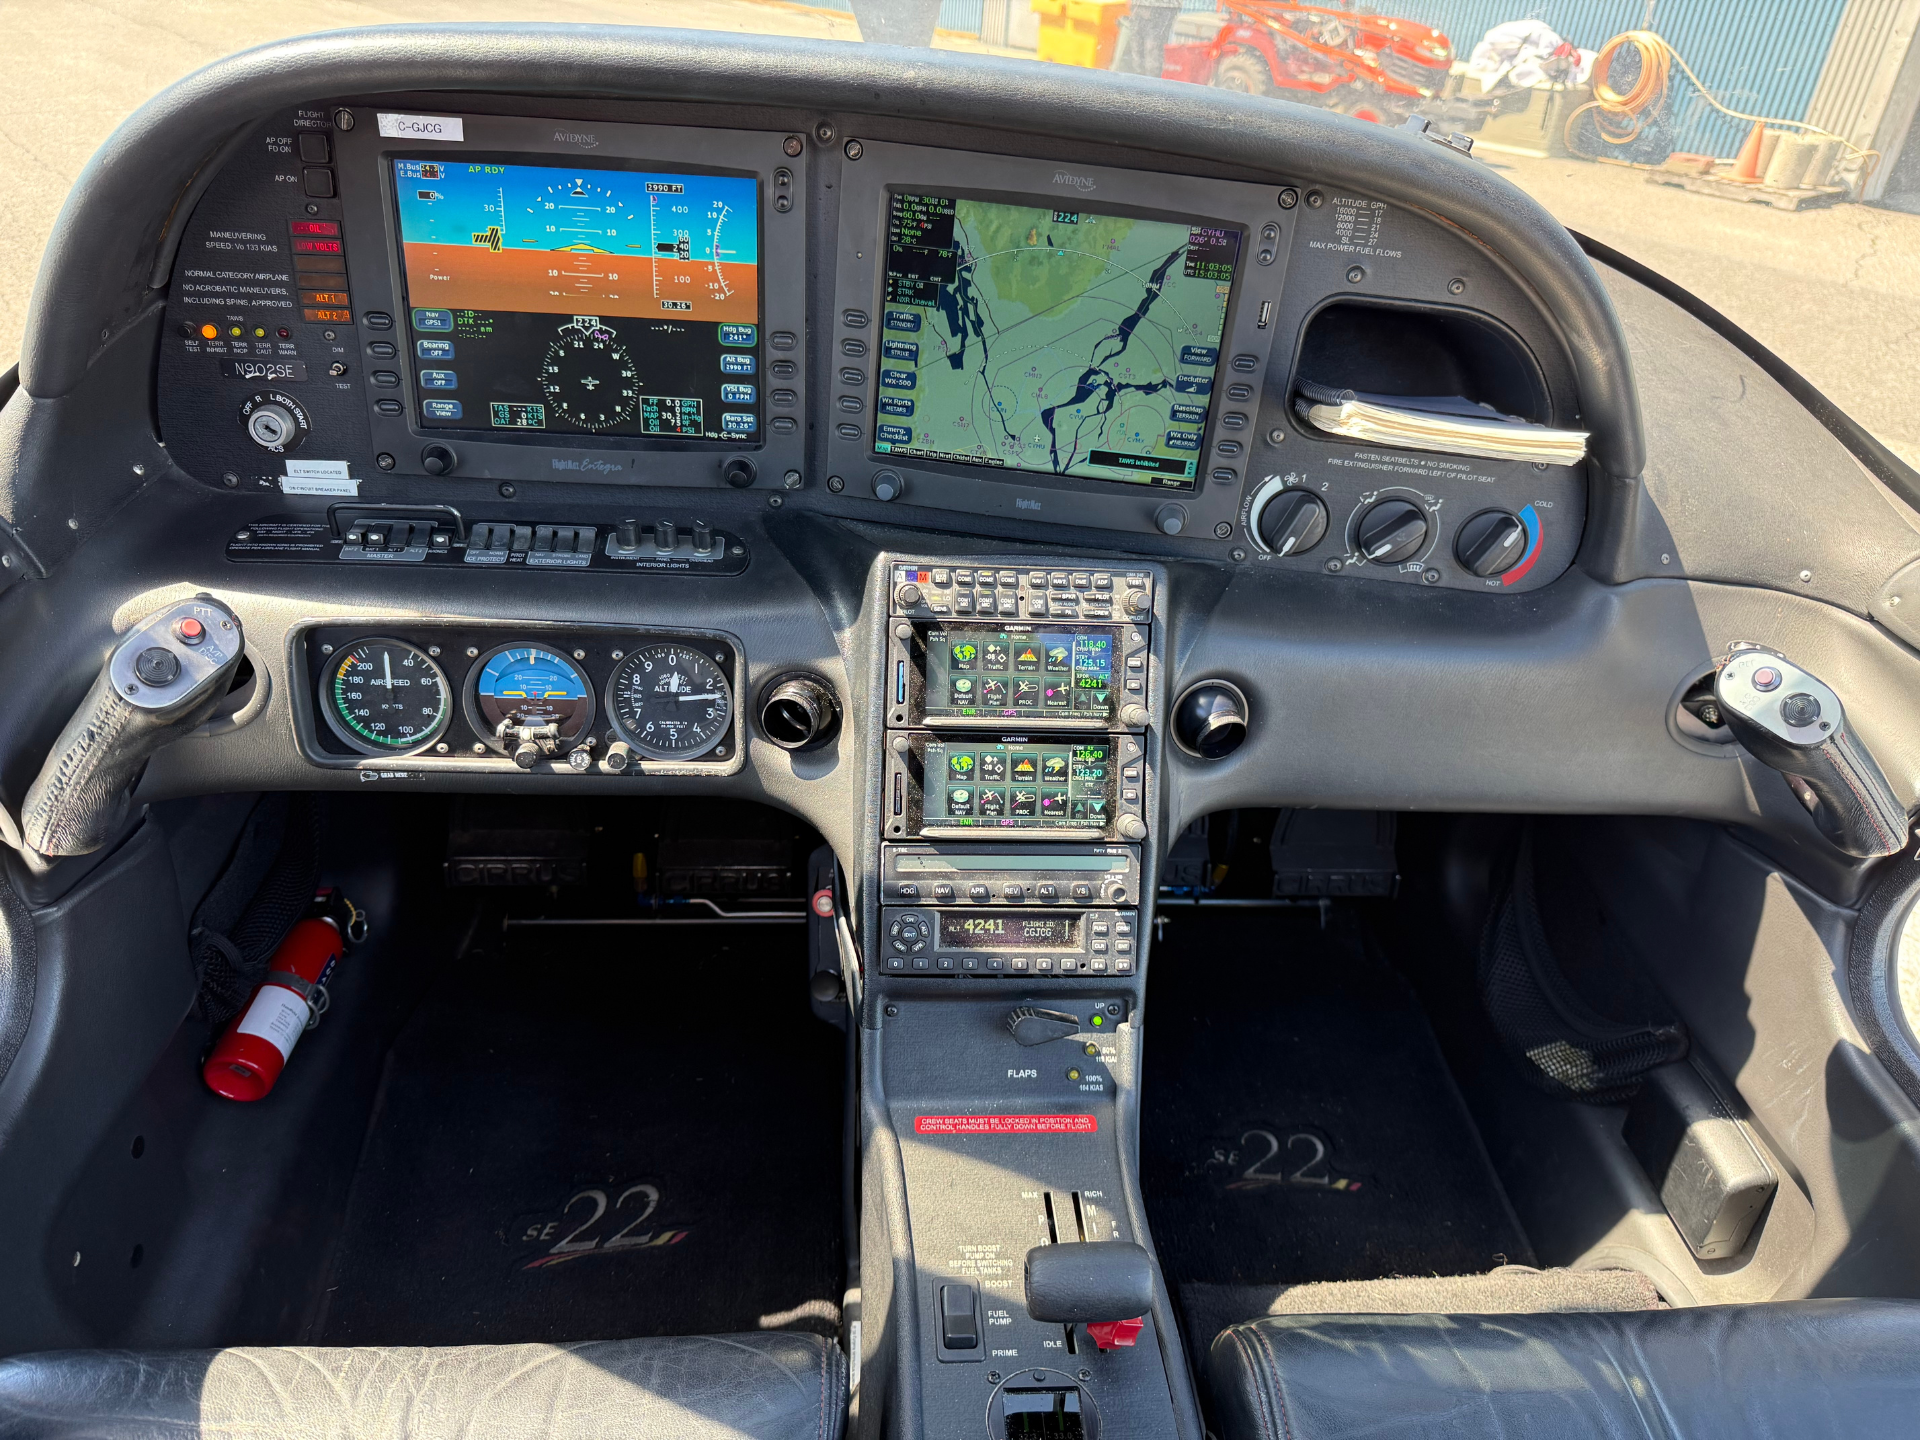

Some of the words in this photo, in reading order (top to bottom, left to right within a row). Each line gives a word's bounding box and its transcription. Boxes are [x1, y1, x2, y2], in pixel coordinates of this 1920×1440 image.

[298, 110, 325, 119] FLIGHT
[294, 118, 332, 128] DIRECTOR
[398, 122, 442, 134] C-GJCG
[554, 132, 596, 144] AVIDYNE
[484, 166, 506, 174] RDY
[1053, 173, 1095, 186] AVIDYNE
[648, 184, 668, 192] 2990
[672, 185, 683, 193] FT
[1332, 198, 1368, 208] ALTITUDE
[672, 206, 688, 214] 400
[1336, 207, 1356, 216] 16000
[1058, 212, 1078, 224] 224
[1335, 214, 1355, 222] 12000
[309, 224, 322, 232] OIL
[1336, 222, 1354, 230] 8000
[210, 231, 266, 240] MANEUVERING
[902, 228, 922, 236] None
[1202, 228, 1224, 237] CYHU
[1336, 229, 1352, 237] 4000
[206, 242, 234, 250] SPEED:
[246, 243, 260, 251] 133
[260, 244, 278, 252] KIAS
[296, 242, 313, 251] LOW
[314, 243, 338, 252] VOLTS
[1310, 240, 1326, 250] MAX
[1328, 242, 1354, 252] POWER
[1356, 246, 1374, 255] FUEL
[1376, 248, 1402, 258] FLOWS
[1196, 262, 1232, 272] 11:03:05
[185, 270, 216, 279] NORMAL
[216, 271, 254, 280] CATEGORY
[255, 273, 290, 282] AIRPLANE
[1194, 270, 1231, 280] 15:03:05
[674, 276, 690, 284] 100
[182, 284, 194, 292] NO
[194, 284, 238, 293] ACROBATIC
[239, 286, 290, 296] MANEUVERS,
[184, 296, 225, 306] INCLUDING
[226, 298, 251, 307] SPINS,
[252, 299, 292, 308] APPROVED
[316, 294, 330, 303] ALT
[331, 294, 336, 303] 1
[317, 311, 330, 320] ALT
[332, 312, 338, 320] 2
[892, 312, 914, 320] Traffic
[890, 320, 914, 328] STANDBY
[424, 342, 449, 350] Bearing
[886, 340, 916, 350] Lightning
[1184, 354, 1212, 363] FORWARD
[235, 362, 295, 378] N902SE
[885, 378, 912, 386] WX-500
[1178, 375, 1209, 384] Declutter
[276, 394, 296, 410] BOTH
[1174, 404, 1203, 414] BaseMap
[294, 407, 308, 430] START
[1354, 452, 1381, 462] FASTEN
[1381, 455, 1419, 466] SEATBELTS
[1438, 461, 1470, 472] SMOKING
[1344, 460, 1394, 472] EXTINGUISHER
[1394, 466, 1428, 476] FORWARD
[1428, 470, 1446, 478] LEFT
[1457, 472, 1478, 482] PILOT
[1478, 475, 1496, 484] SEAT
[1534, 500, 1554, 508] COLD
[1241, 495, 1252, 526] AIRFLOW
[194, 606, 212, 616] PTT
[1080, 640, 1106, 648] 118.40
[357, 662, 373, 670] 200
[1080, 659, 1106, 668] 125.15
[1079, 678, 1103, 688] 4241
[370, 723, 386, 731] 120
[1076, 750, 1103, 759] 126.40
[1076, 768, 1102, 776] 123.20
[1076, 886, 1086, 894] VS
[964, 919, 1004, 934] 4241
[1024, 928, 1052, 938] CGJCG
[1008, 1070, 1037, 1078] FLAPS
[1214, 1149, 1239, 1166] SE
[1241, 1130, 1330, 1184] 22
[1084, 1190, 1103, 1198] RICH
[522, 1222, 558, 1241] SE
[549, 1184, 660, 1254] 22
